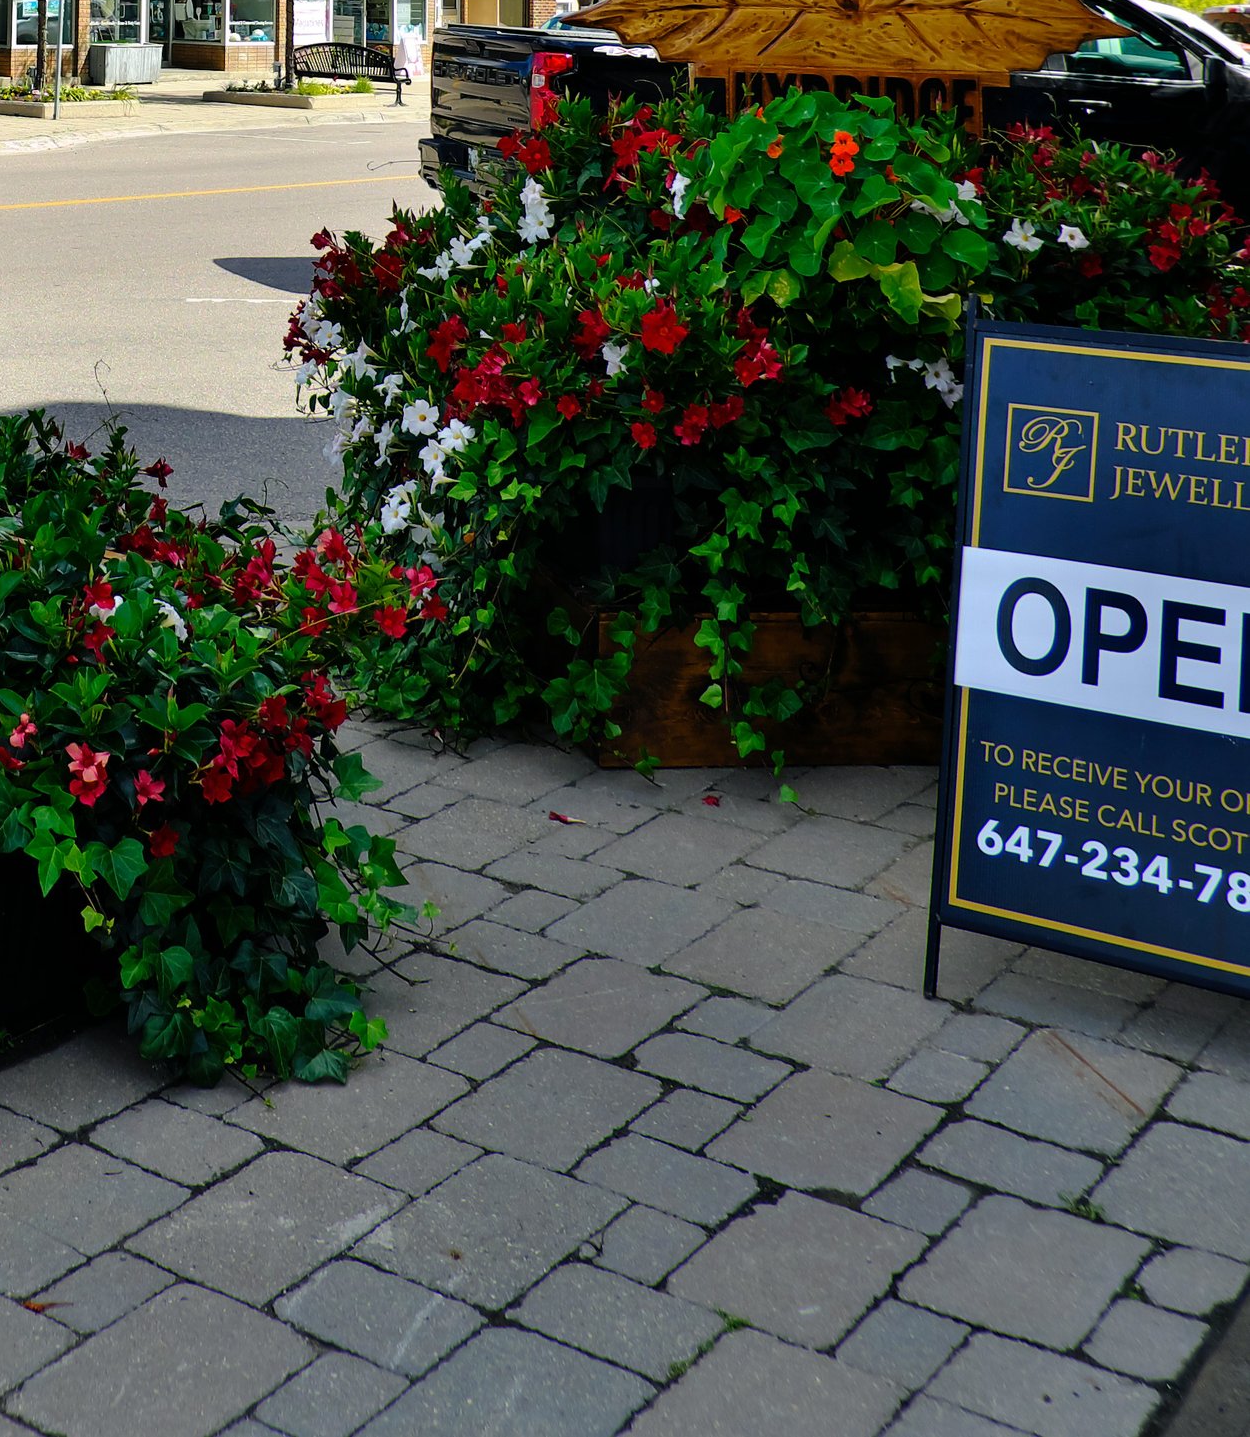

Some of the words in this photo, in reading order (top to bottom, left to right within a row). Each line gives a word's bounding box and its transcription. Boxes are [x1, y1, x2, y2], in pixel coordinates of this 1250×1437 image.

[433, 60, 521, 86] CHEVROLET
[1114, 421, 1250, 466] RUTLE
[1110, 465, 1250, 511] JEWELL
[996, 576, 1250, 714] OPE
[980, 740, 1014, 767] TO
[1022, 749, 1128, 790] RECEIVE
[1134, 771, 1212, 807] YOUR
[1220, 789, 1250, 815] O
[994, 782, 1090, 823] PLEASE
[1097, 805, 1165, 839] CALL
[1171, 819, 1249, 854] SCOT
[977, 819, 1250, 913] 647-234-78
